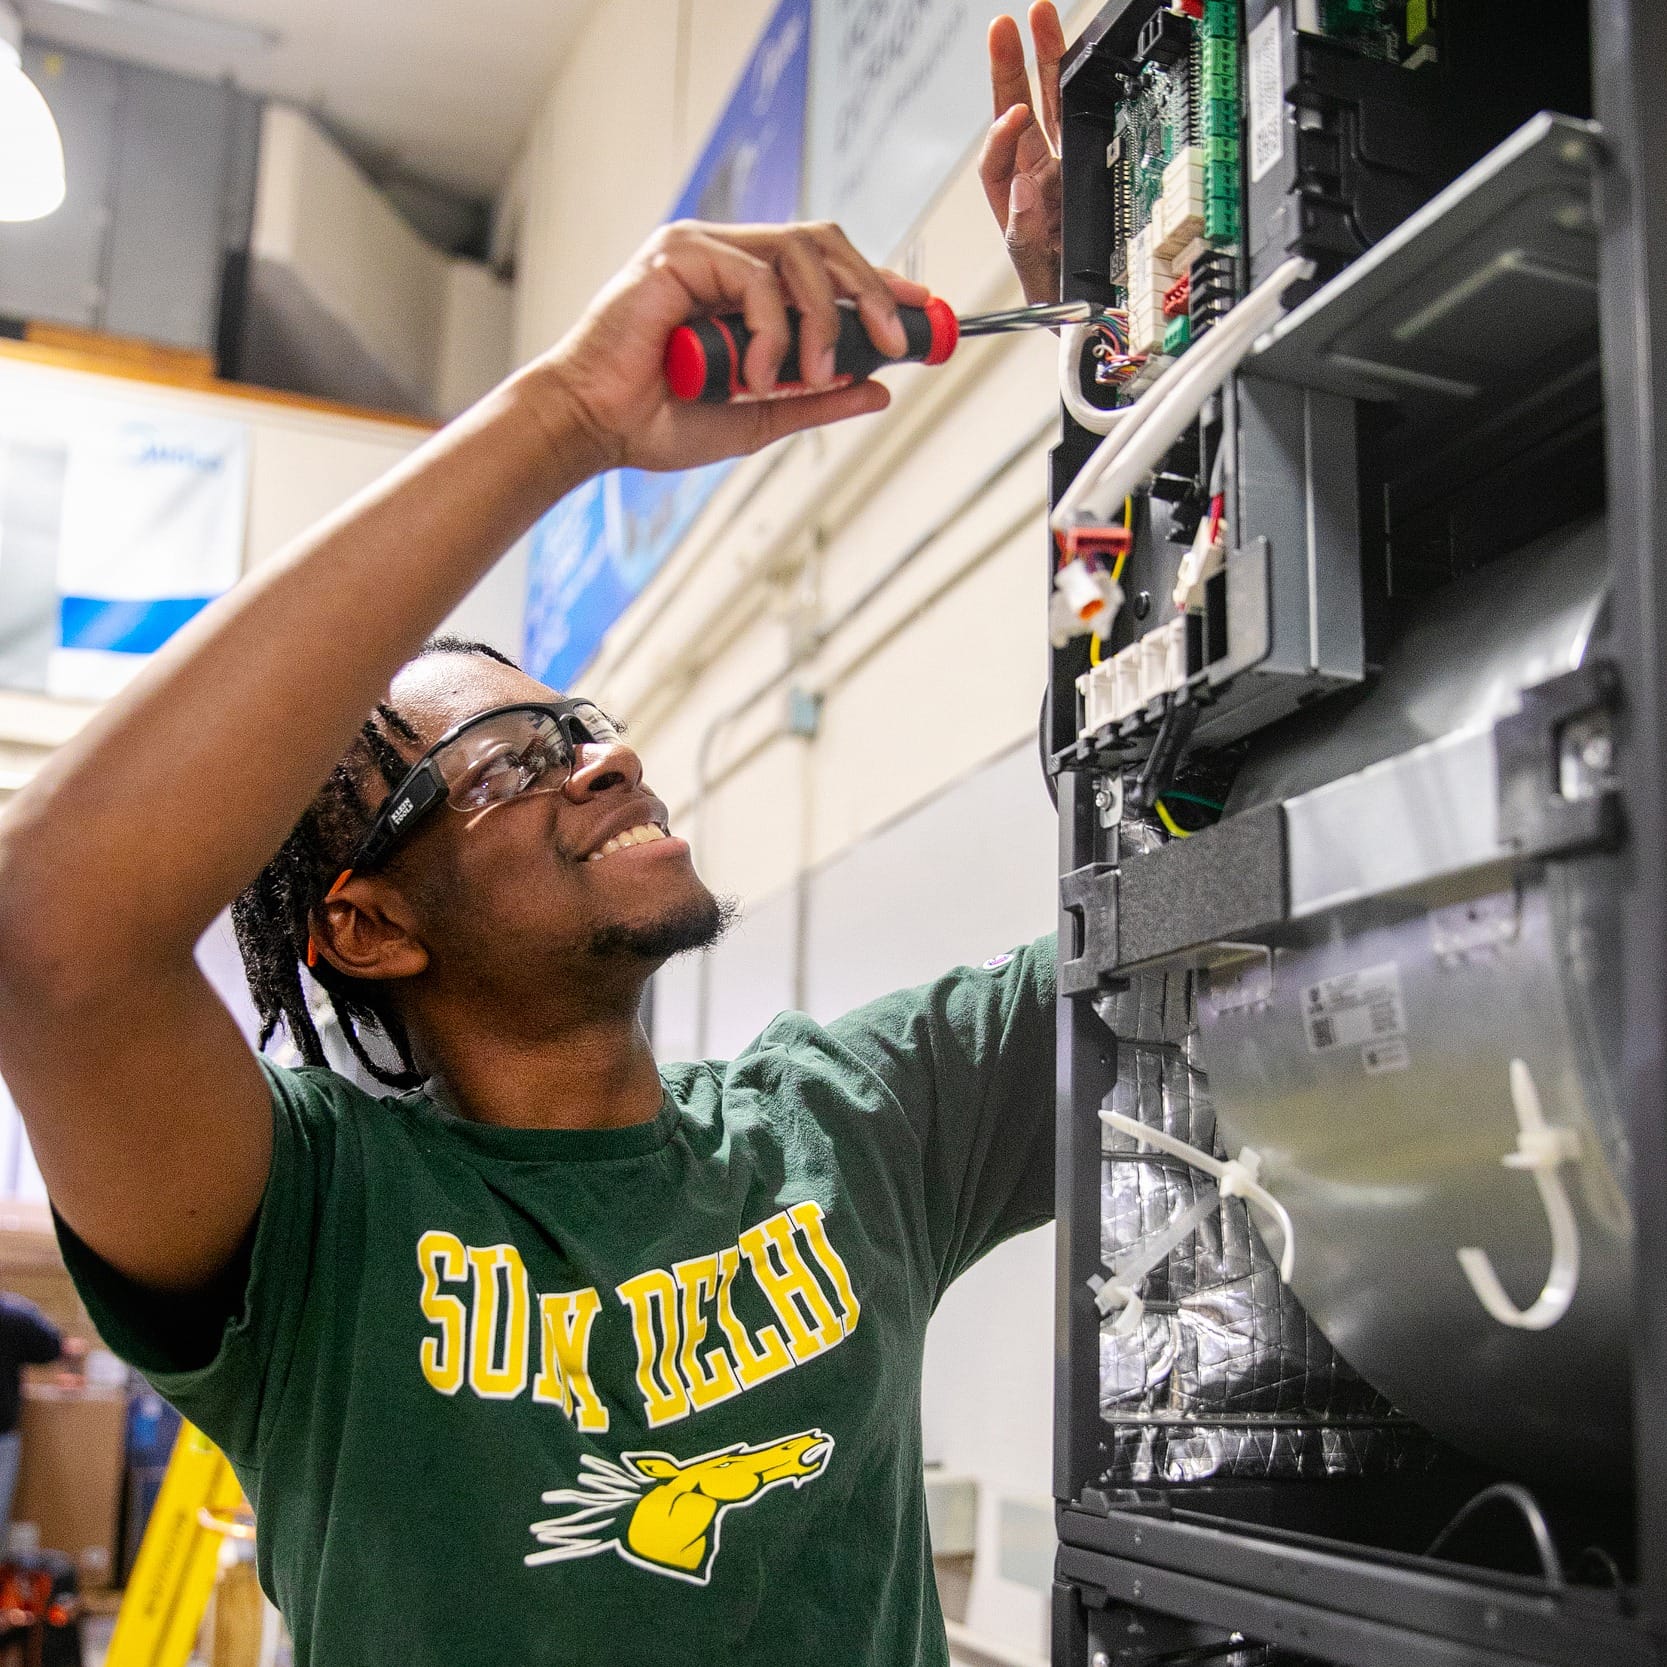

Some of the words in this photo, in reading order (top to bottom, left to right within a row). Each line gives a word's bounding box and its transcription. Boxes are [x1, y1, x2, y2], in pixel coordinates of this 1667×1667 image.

[391, 797, 411, 821] KLEIN
[394, 802, 414, 825] TOOLS
[615, 1199, 861, 1429] DELHI
